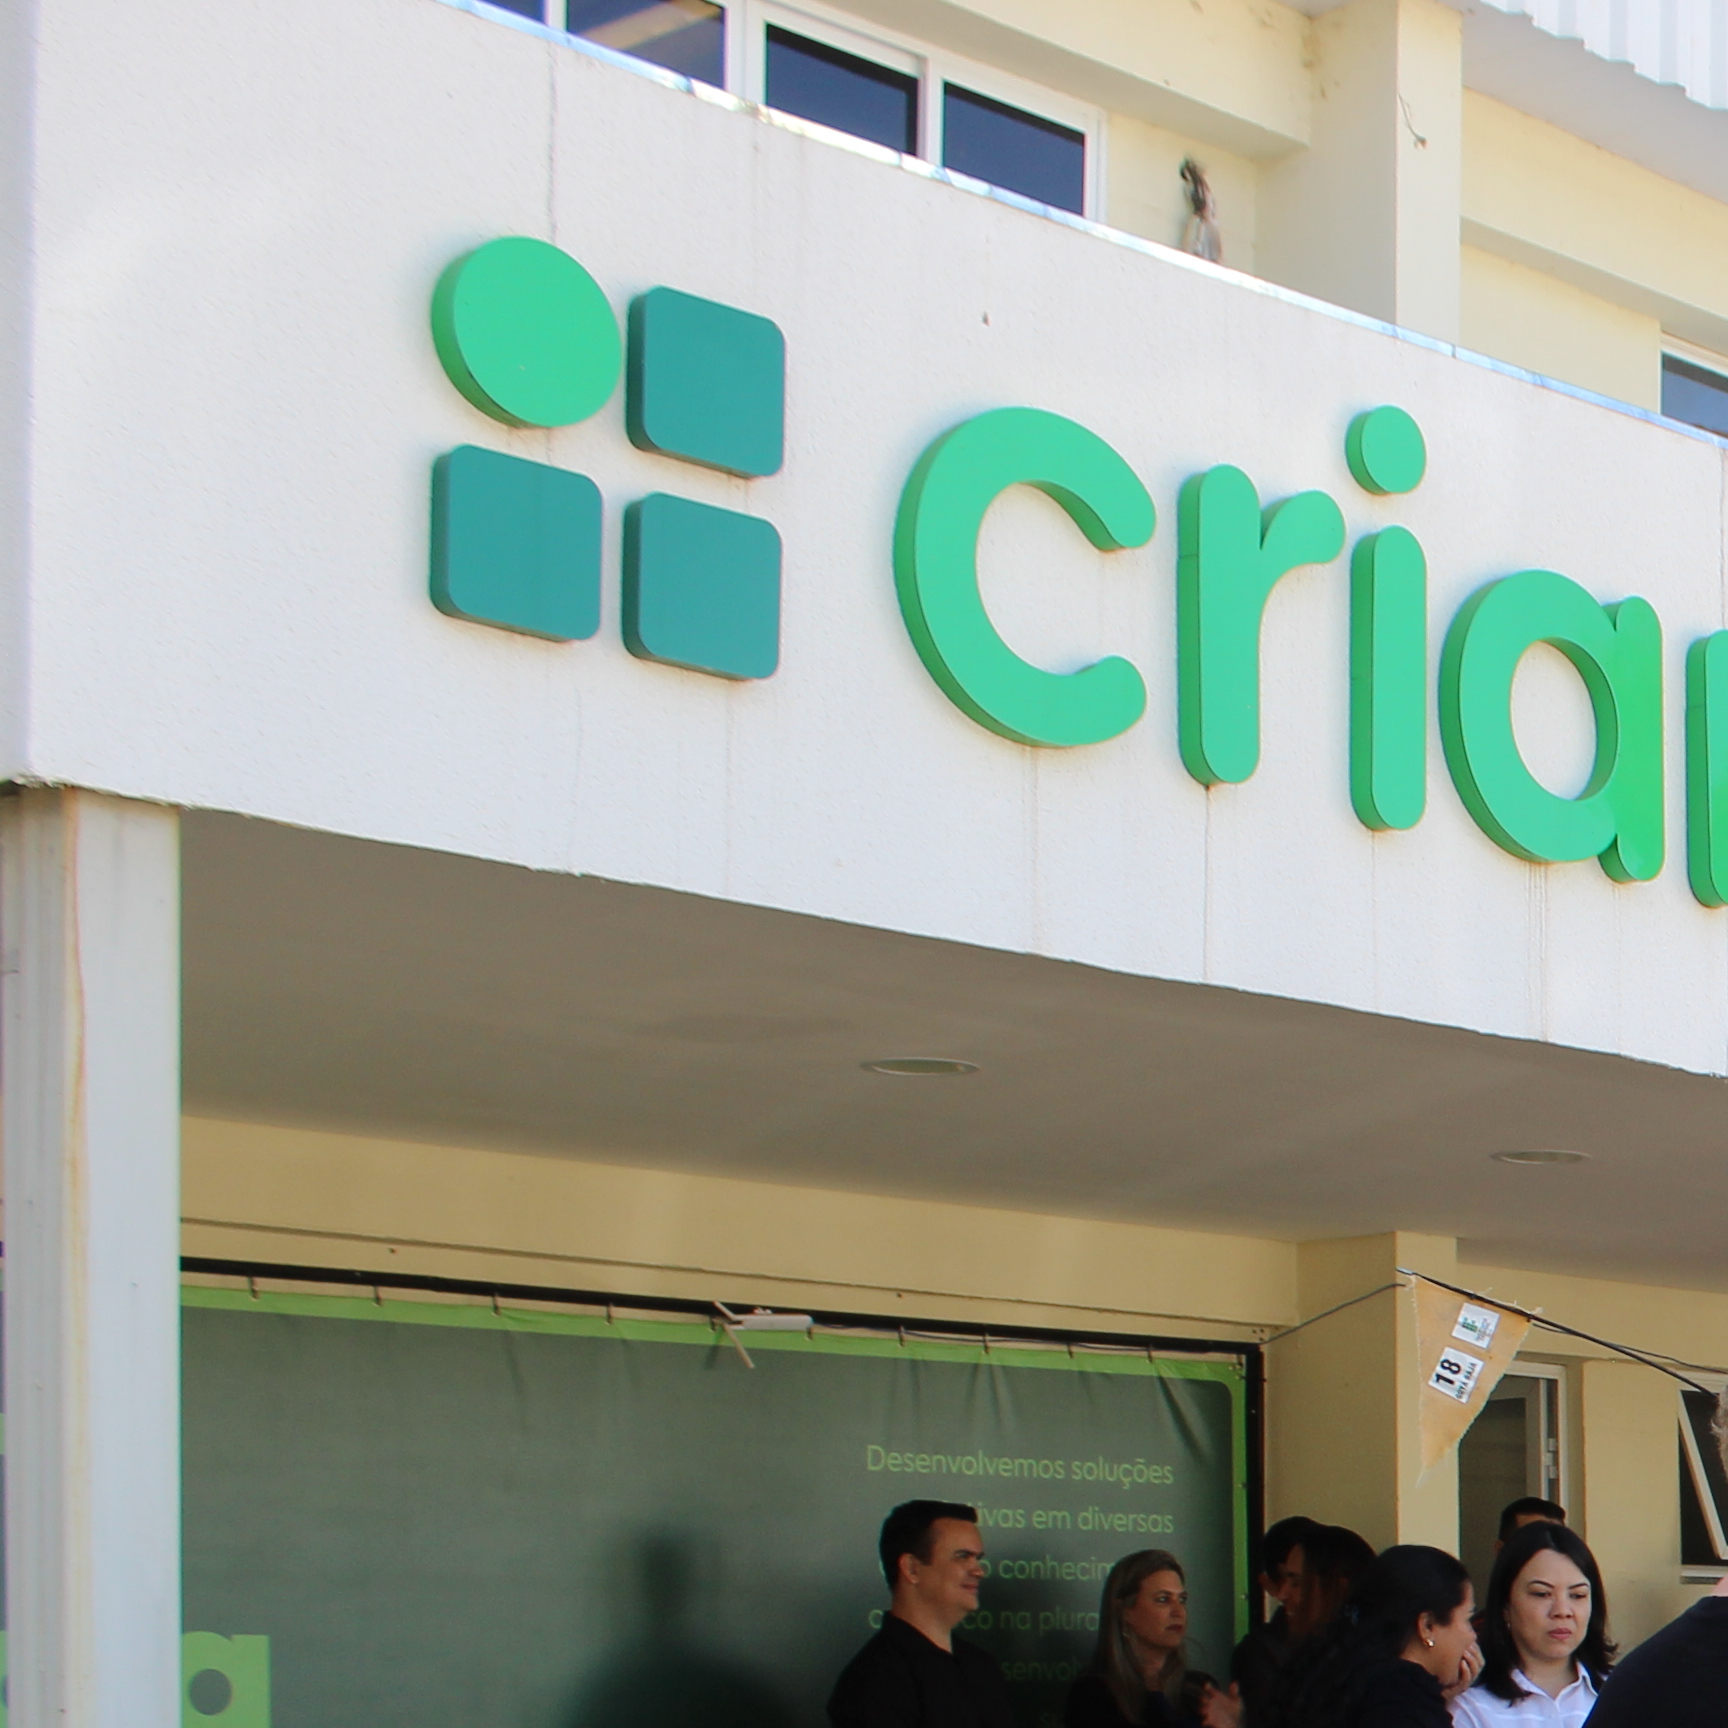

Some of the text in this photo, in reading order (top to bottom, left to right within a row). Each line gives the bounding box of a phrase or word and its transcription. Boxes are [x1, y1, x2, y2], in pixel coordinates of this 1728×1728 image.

[1435, 1358, 1461, 1385] 18
[866, 1445, 1175, 1489] Desenvolvemos soluções
[1033, 1509, 1071, 1530] em
[1078, 1504, 1175, 1534] diversas
[1001, 1609, 1031, 1631] na
[1039, 1607, 1099, 1637] plura
